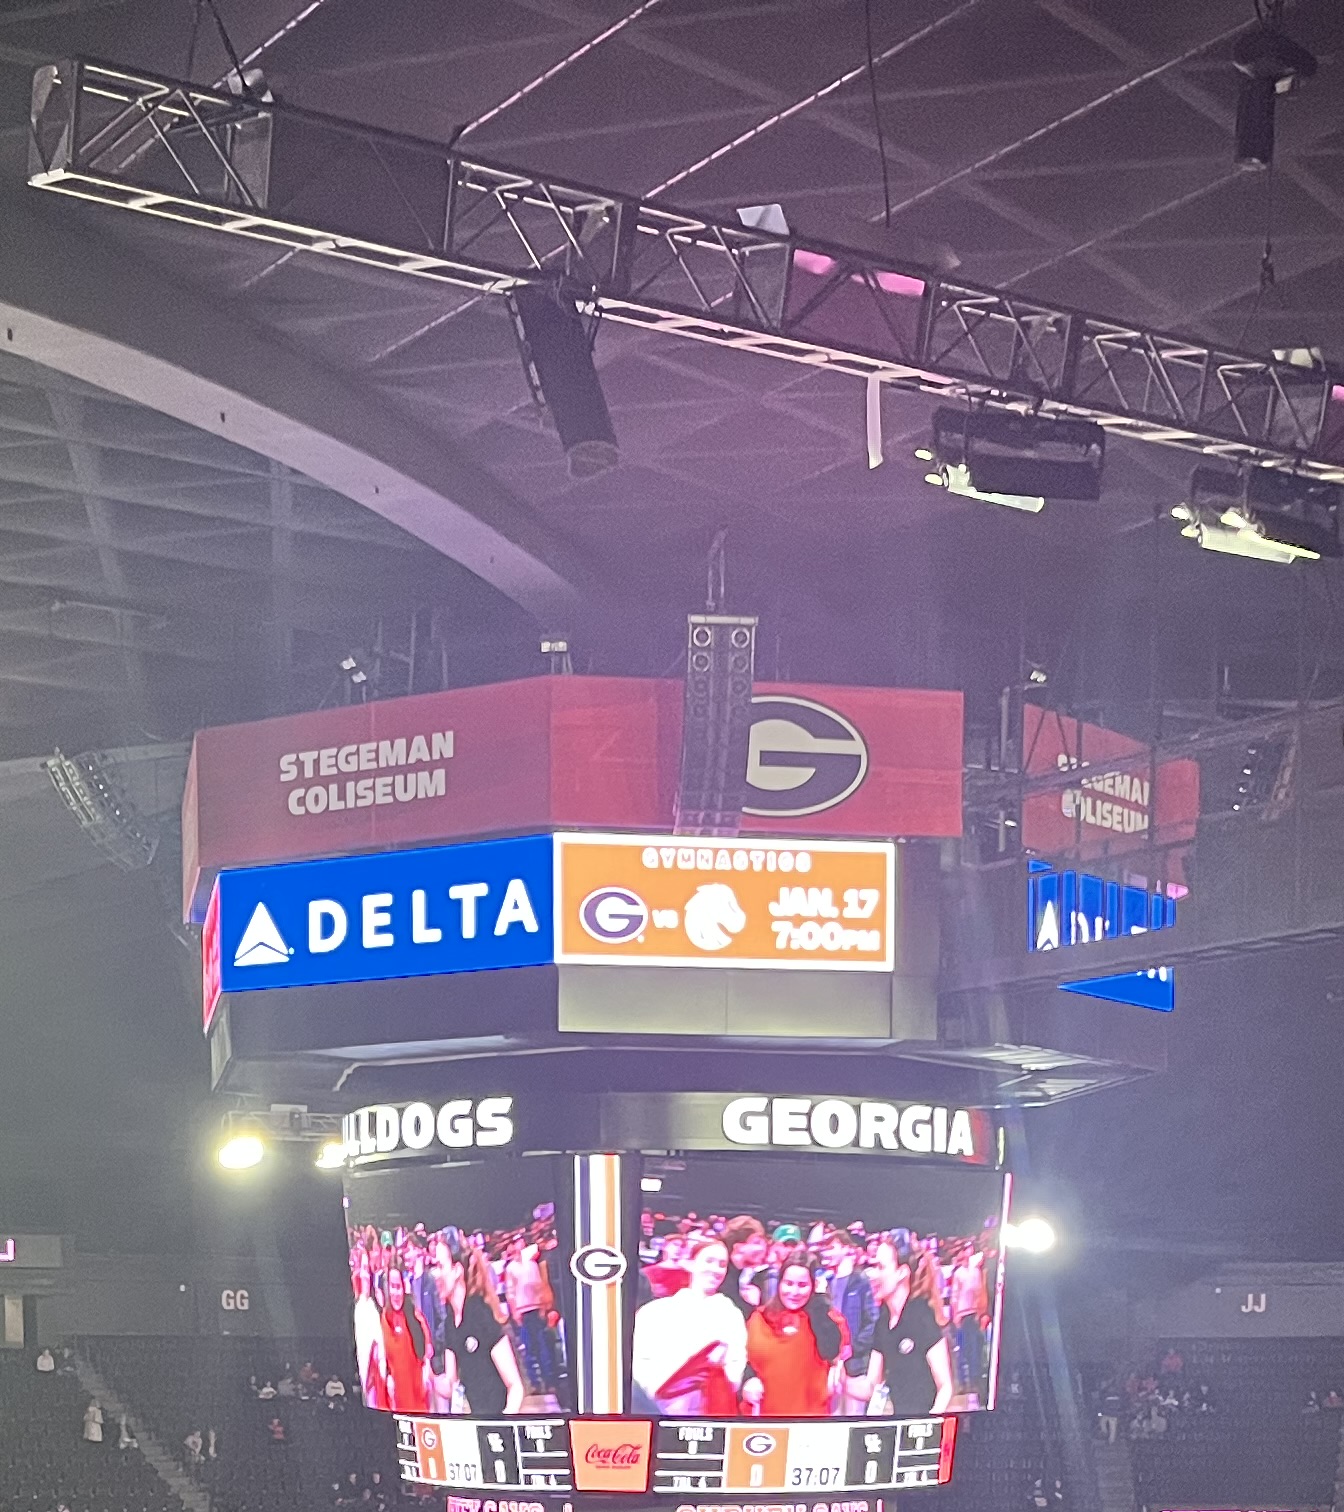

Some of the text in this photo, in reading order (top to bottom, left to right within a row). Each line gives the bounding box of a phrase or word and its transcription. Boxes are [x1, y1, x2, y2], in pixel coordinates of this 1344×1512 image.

[279, 730, 454, 782] STEGEMAN
[288, 769, 446, 816] COLISEUM
[308, 878, 539, 953] DELTA
[768, 887, 880, 918] JAN. 17
[722, 1096, 975, 1157] GEORGIA
[221, 1289, 249, 1310] GG
[1241, 1293, 1266, 1313] JJ
[791, 1467, 841, 1487] 37:07
